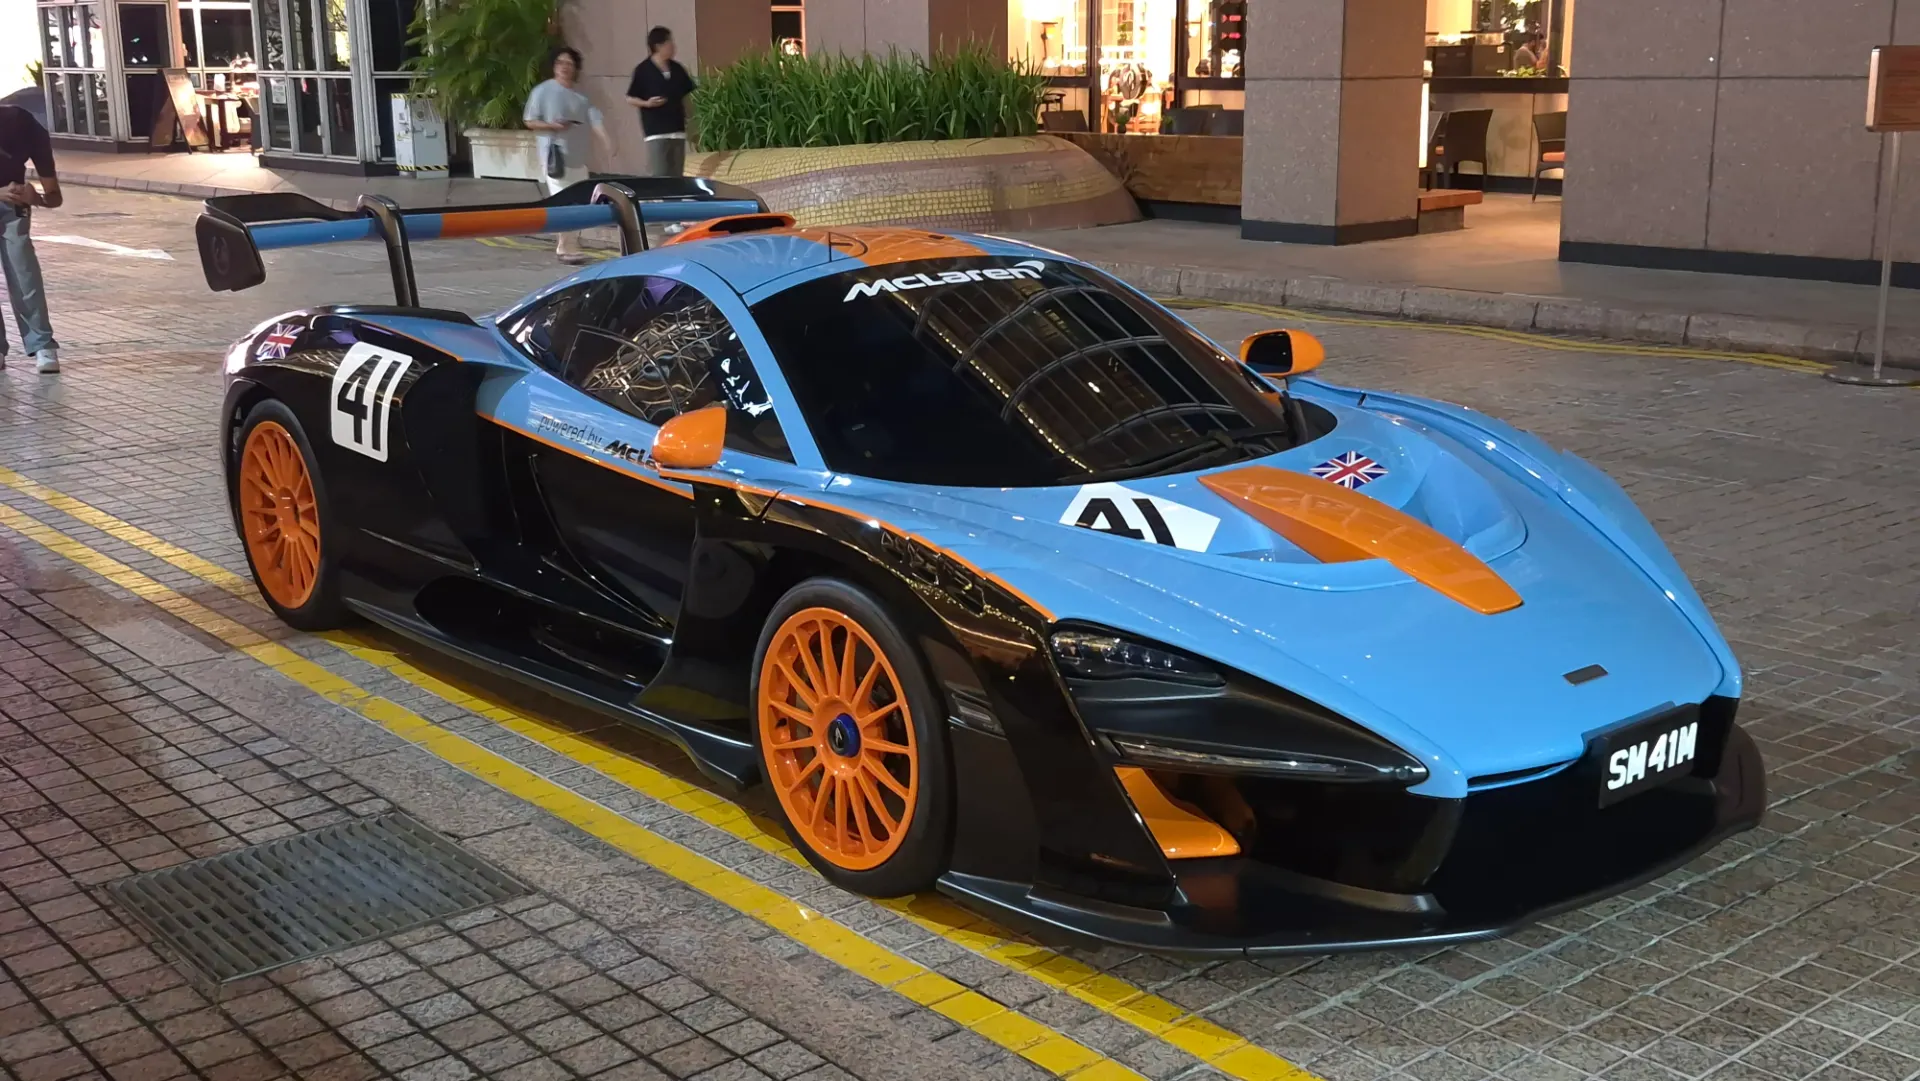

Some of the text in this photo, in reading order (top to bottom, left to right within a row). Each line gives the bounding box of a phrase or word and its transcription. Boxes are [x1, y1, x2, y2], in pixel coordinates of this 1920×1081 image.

[843, 260, 1045, 303] McLaren
[337, 353, 402, 452] 41
[537, 416, 588, 443] powered
[586, 427, 603, 454] by
